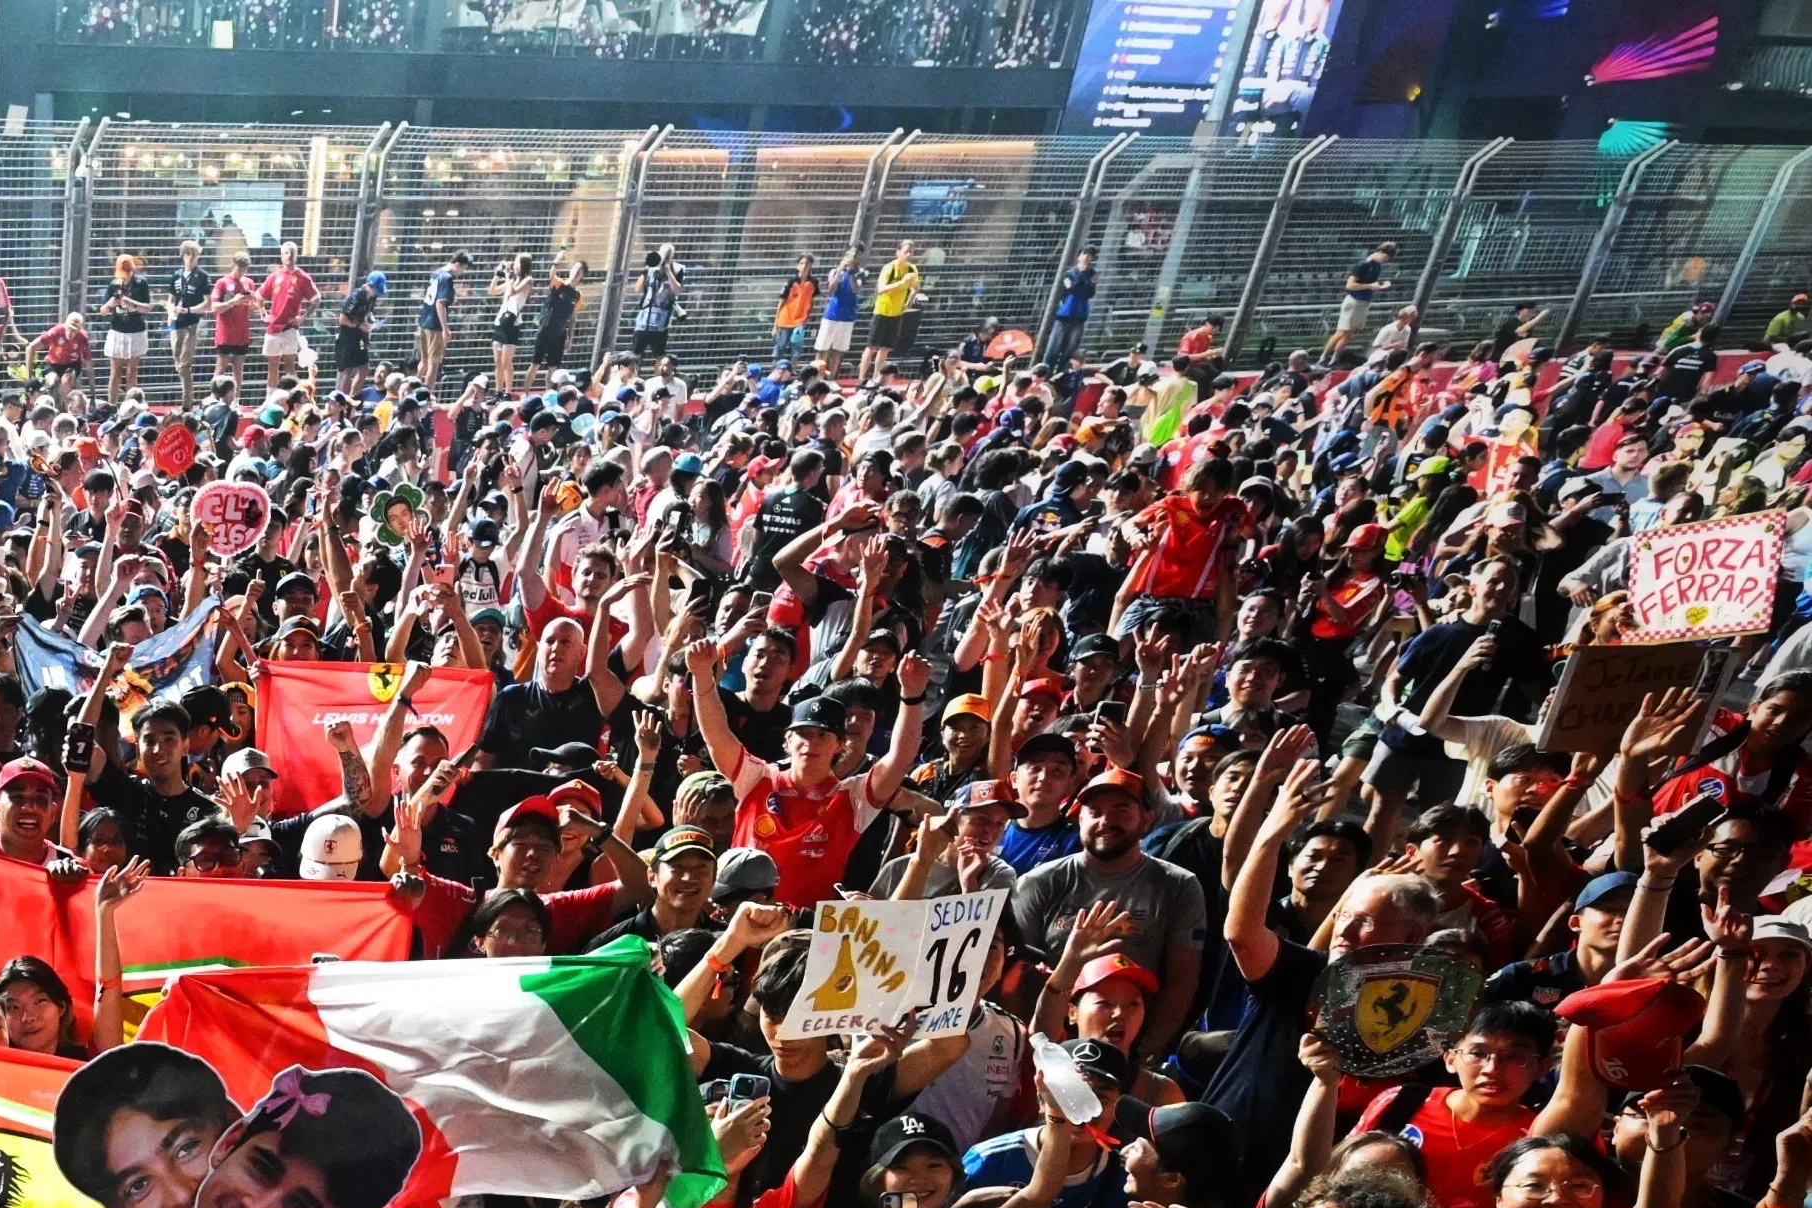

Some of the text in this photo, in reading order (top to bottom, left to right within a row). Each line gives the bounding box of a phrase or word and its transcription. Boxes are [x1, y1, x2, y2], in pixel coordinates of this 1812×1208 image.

[762, 514, 801, 525] PETRONAS
[213, 524, 248, 546] 16
[1653, 537, 1766, 580] FORZA
[313, 712, 368, 725] LEWIS
[819, 898, 992, 993] BANANA SEDICI
[925, 928, 981, 1008] 16
[1601, 1057, 1629, 1081] 16
[900, 1115, 926, 1135] LA
